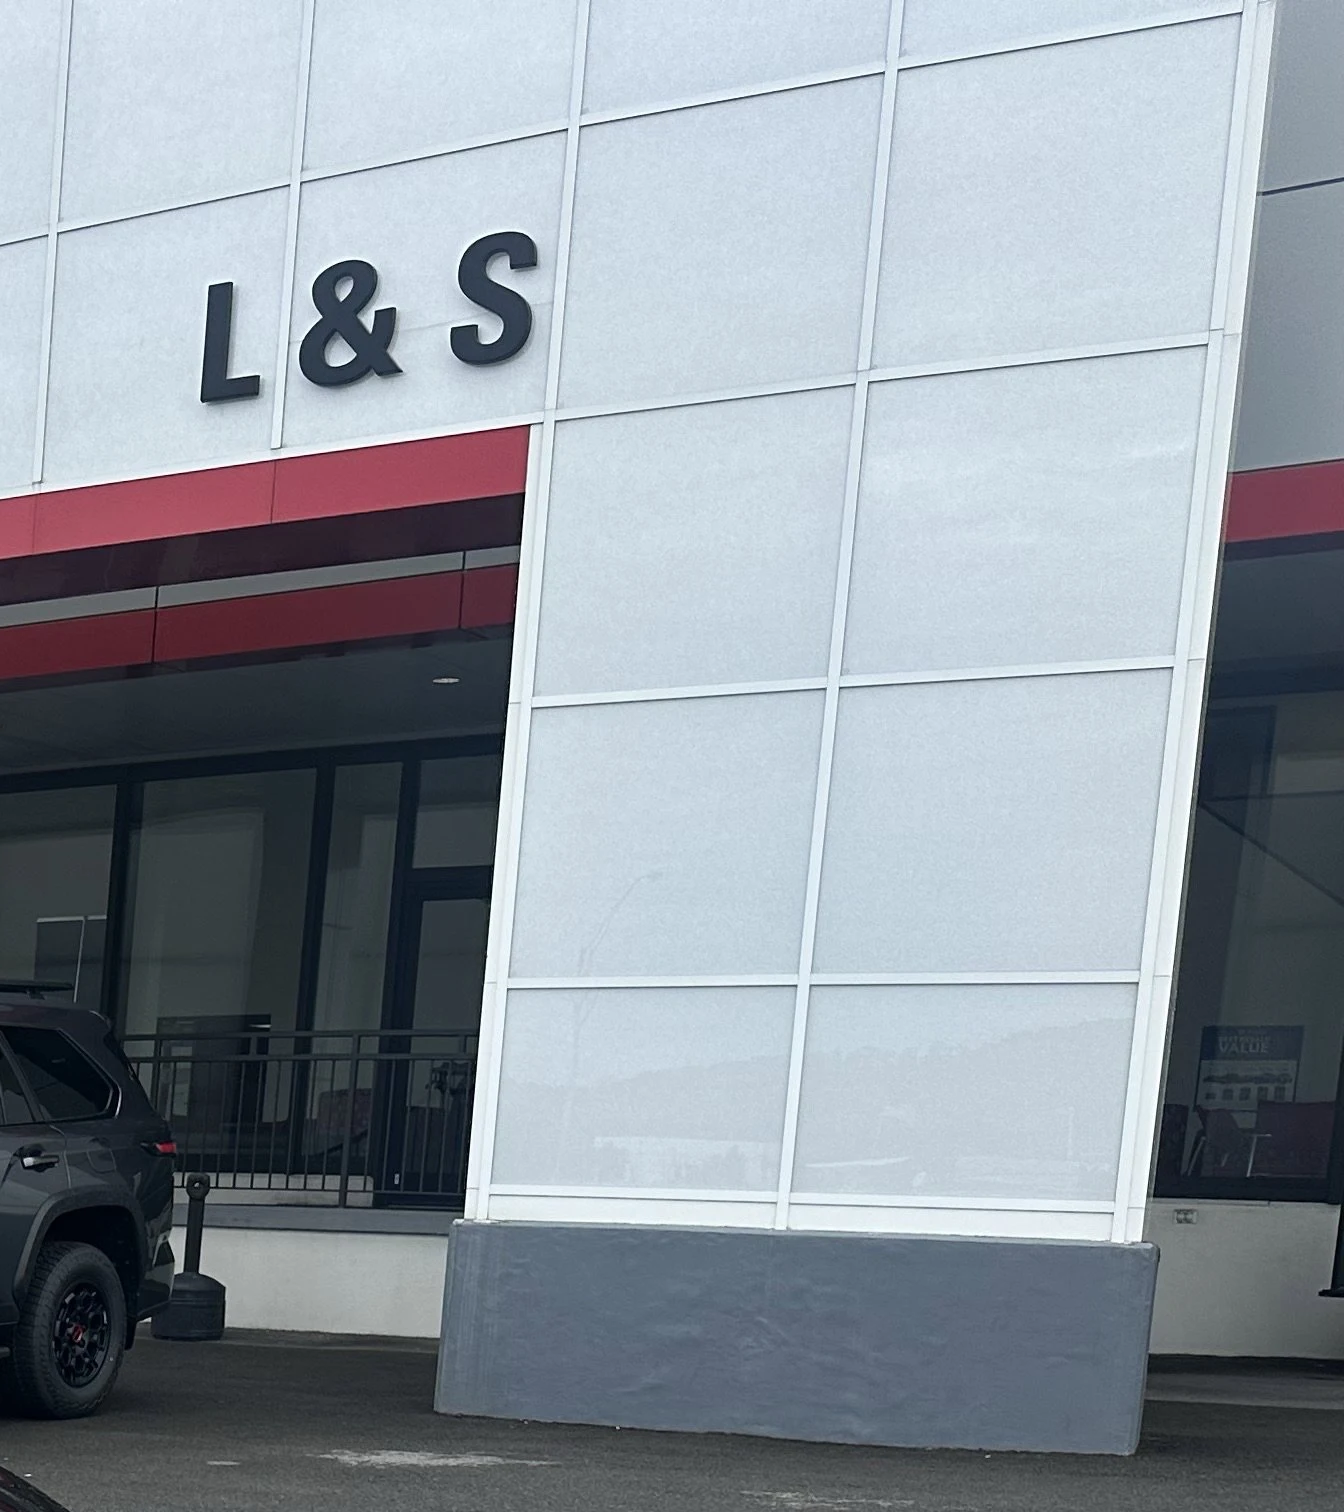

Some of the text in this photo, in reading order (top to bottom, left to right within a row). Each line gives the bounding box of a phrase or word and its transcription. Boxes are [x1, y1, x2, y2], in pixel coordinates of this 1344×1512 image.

[200, 230, 538, 404] L & S
[1219, 1041, 1269, 1054] VALUE
